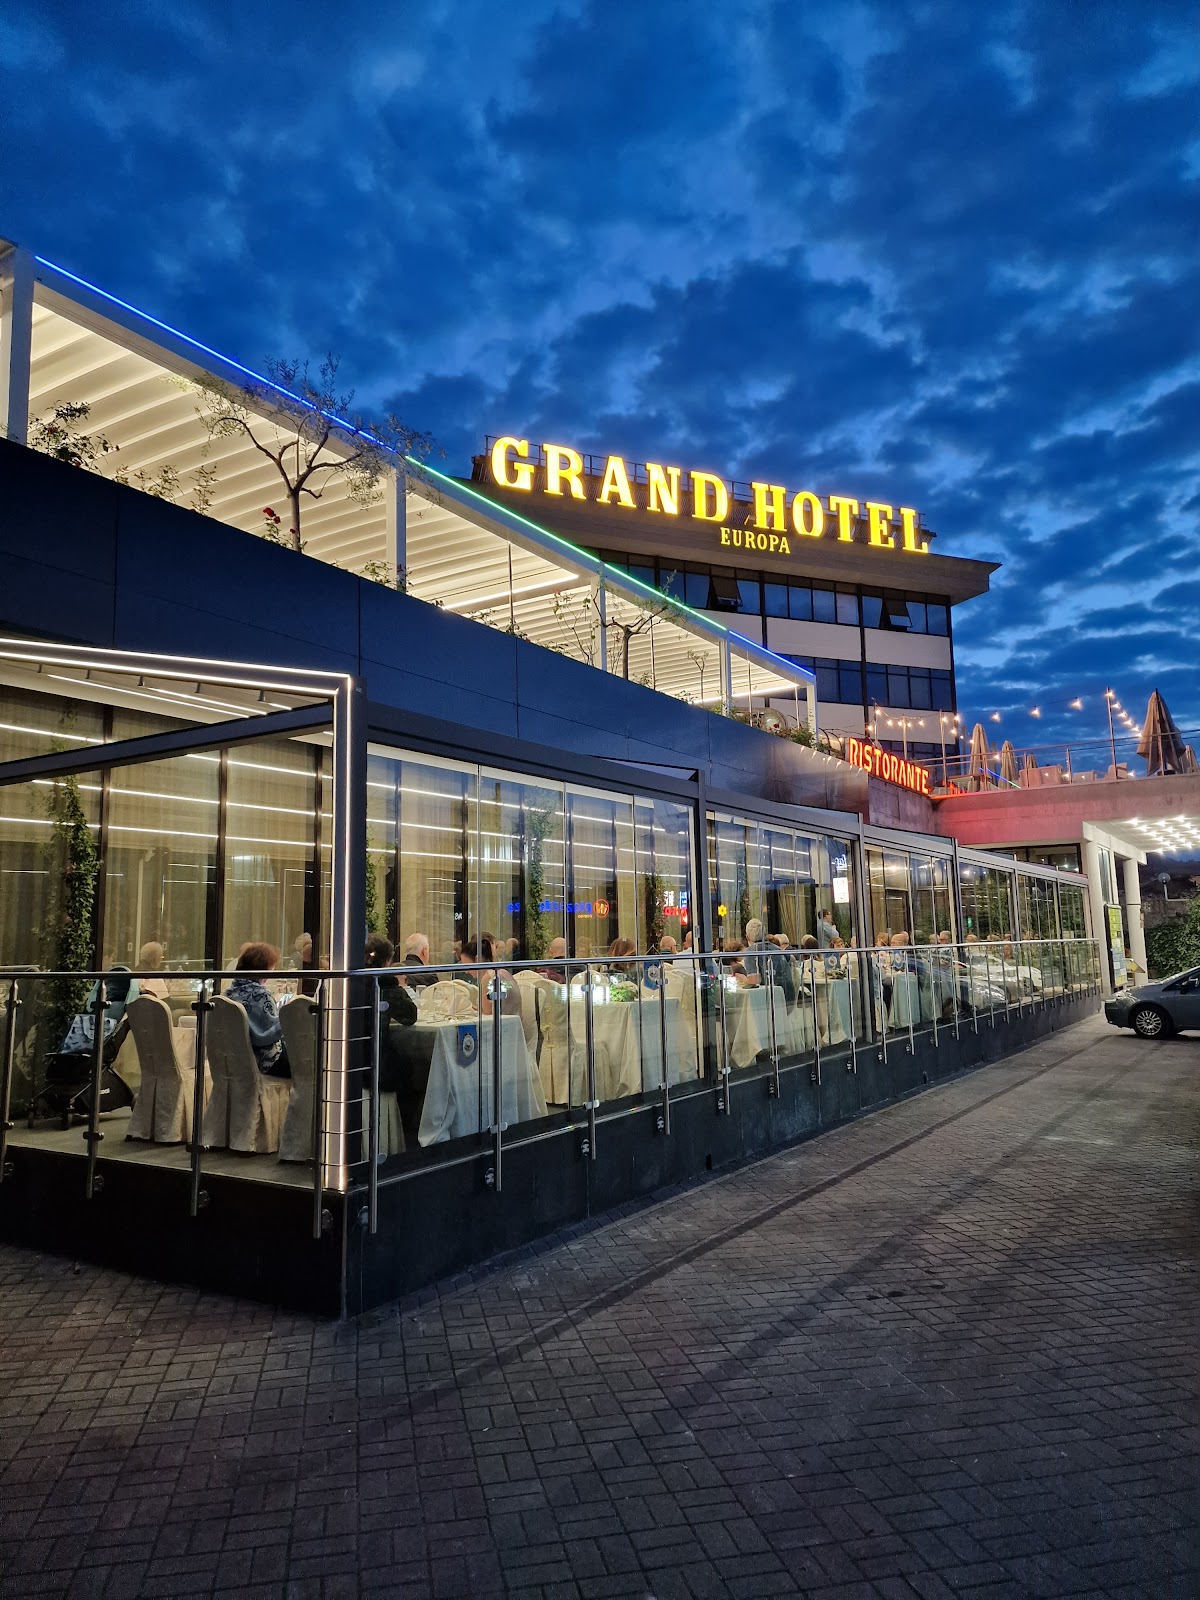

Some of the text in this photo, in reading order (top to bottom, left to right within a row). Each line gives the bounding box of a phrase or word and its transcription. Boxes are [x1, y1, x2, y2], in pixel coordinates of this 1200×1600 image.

[490, 436, 929, 553] GRAND HOTEL
[720, 526, 791, 554] EUROPA
[849, 737, 930, 795] RISTORANTE
